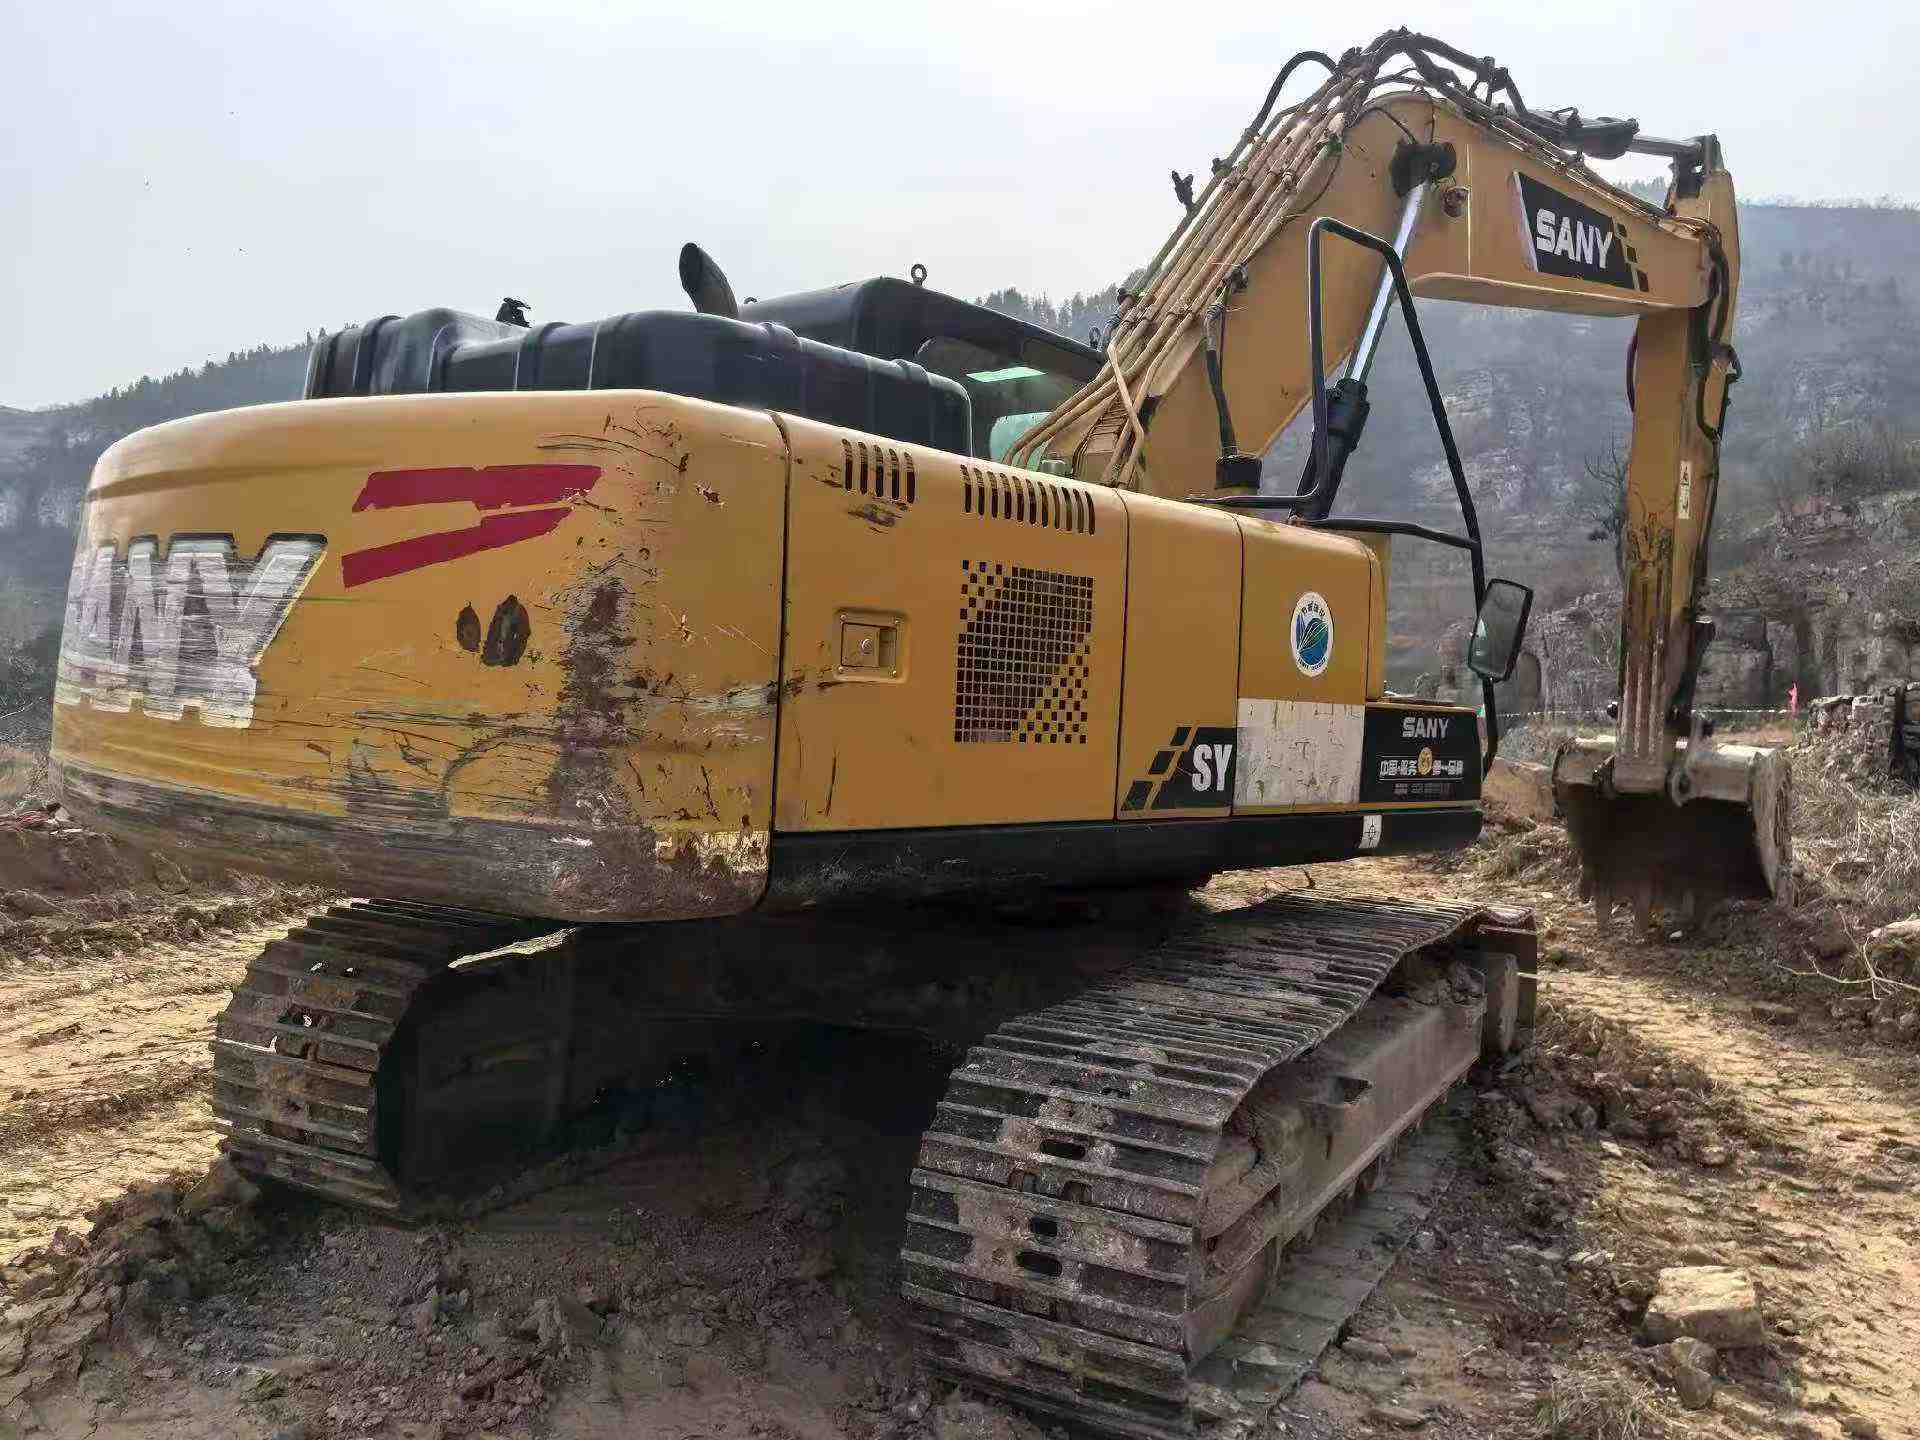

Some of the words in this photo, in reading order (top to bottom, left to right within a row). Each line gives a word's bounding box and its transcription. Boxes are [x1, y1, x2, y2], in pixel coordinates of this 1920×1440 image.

[1536, 208, 1613, 269] SANY
[56, 534, 327, 728] ANY
[1402, 716, 1449, 738] SANY
[1192, 744, 1233, 792] SY
